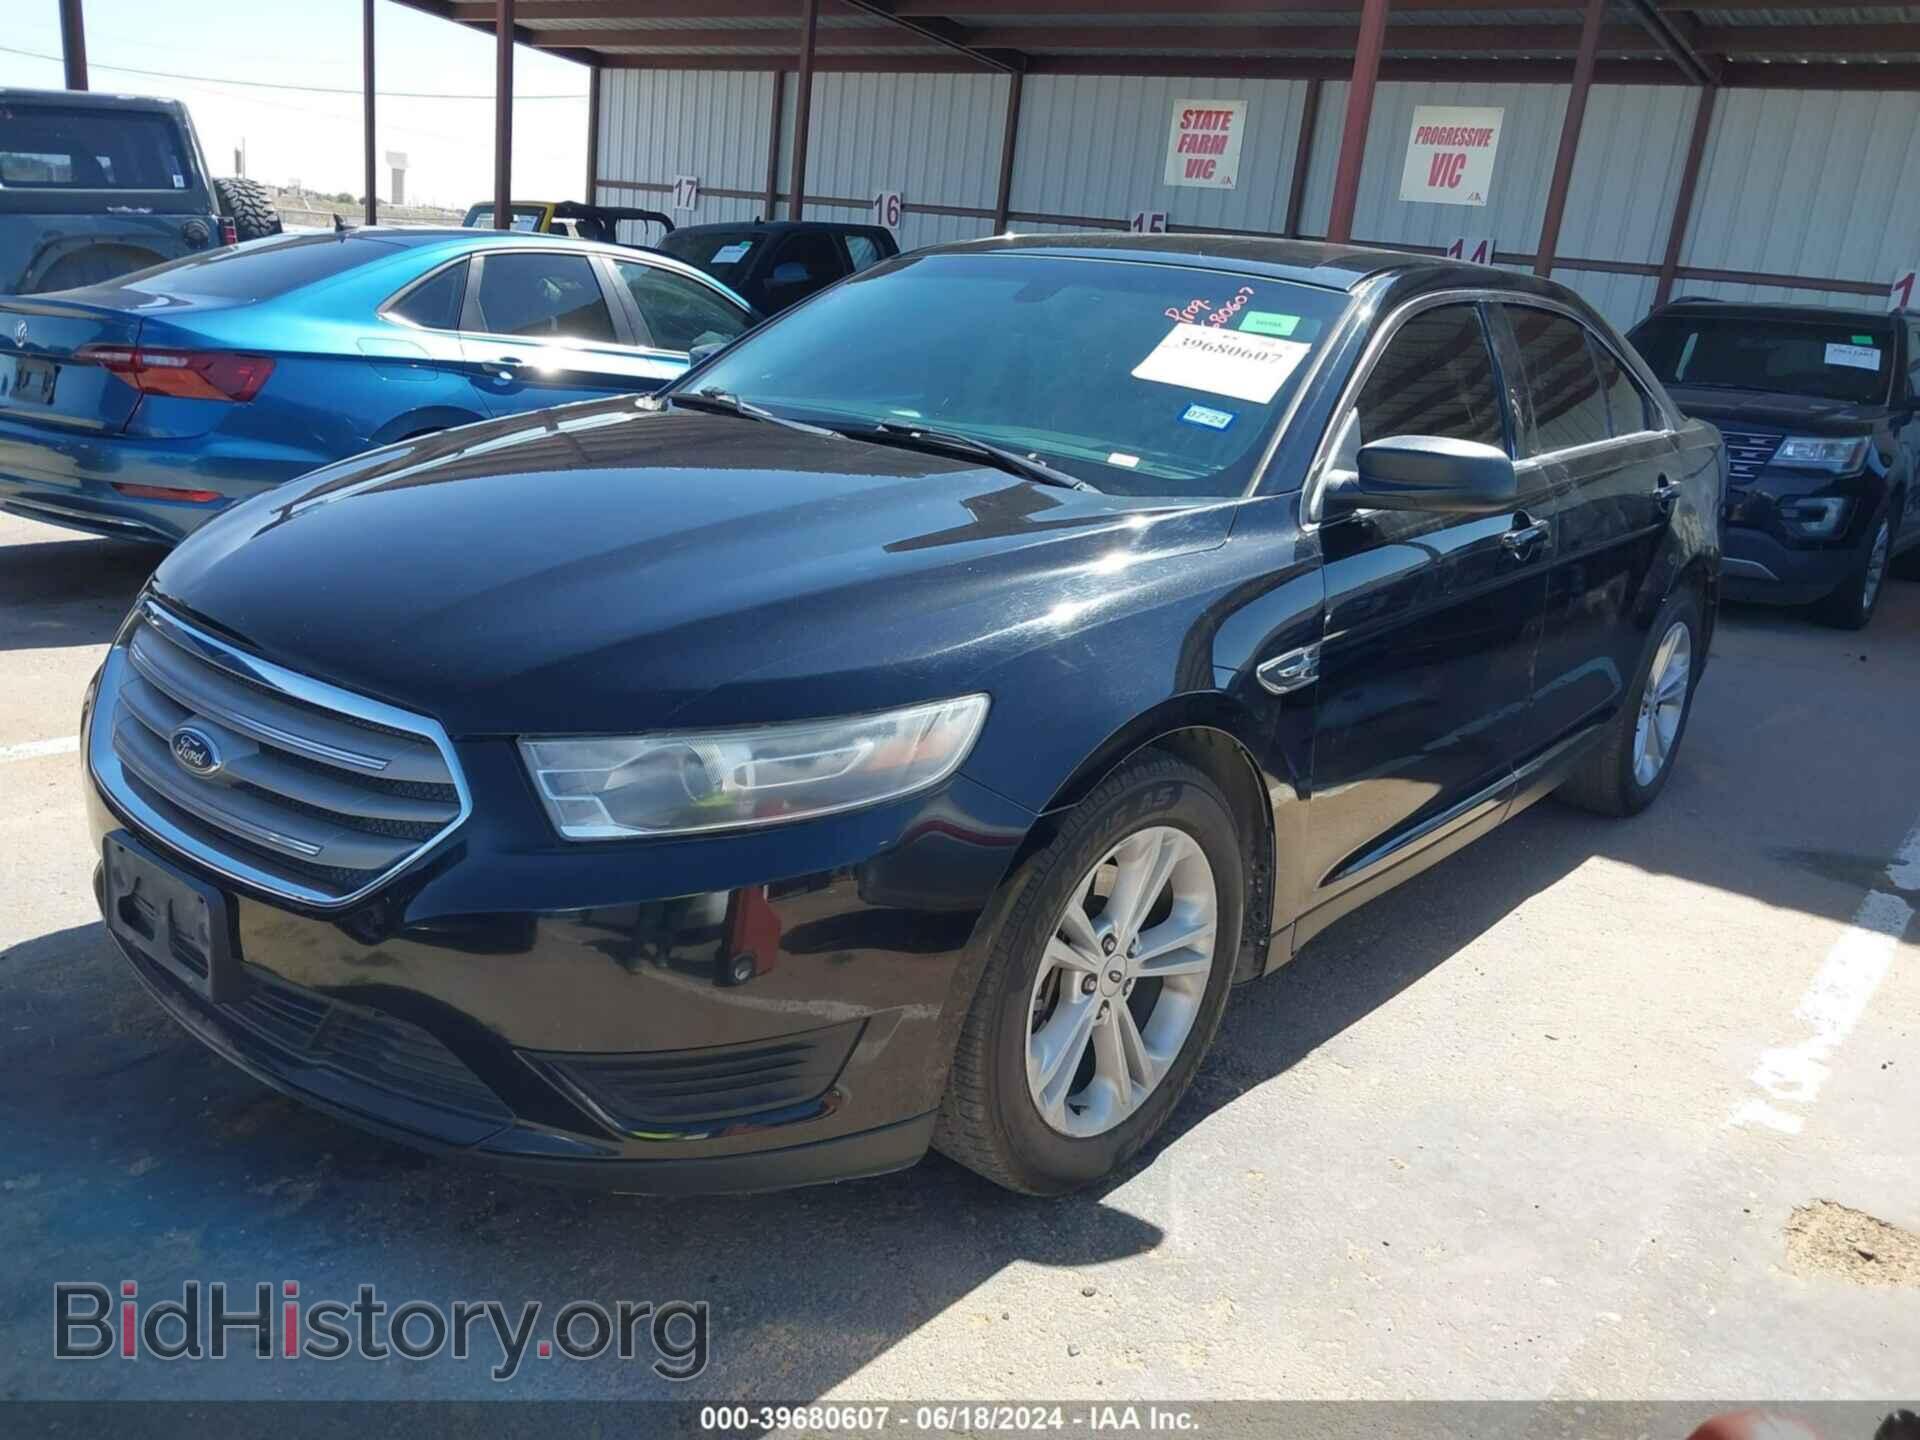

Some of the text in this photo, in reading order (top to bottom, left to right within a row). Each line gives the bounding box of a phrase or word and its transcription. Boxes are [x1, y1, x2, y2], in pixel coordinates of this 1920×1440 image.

[1180, 109, 1234, 131] STATE
[1177, 133, 1229, 155] FARM
[1415, 126, 1495, 148] PROGRESSIVE
[1184, 158, 1217, 180] VIC
[1428, 153, 1467, 189] VIC
[675, 178, 697, 208] 17
[874, 193, 899, 226] 16
[175, 735, 208, 766] Ford
